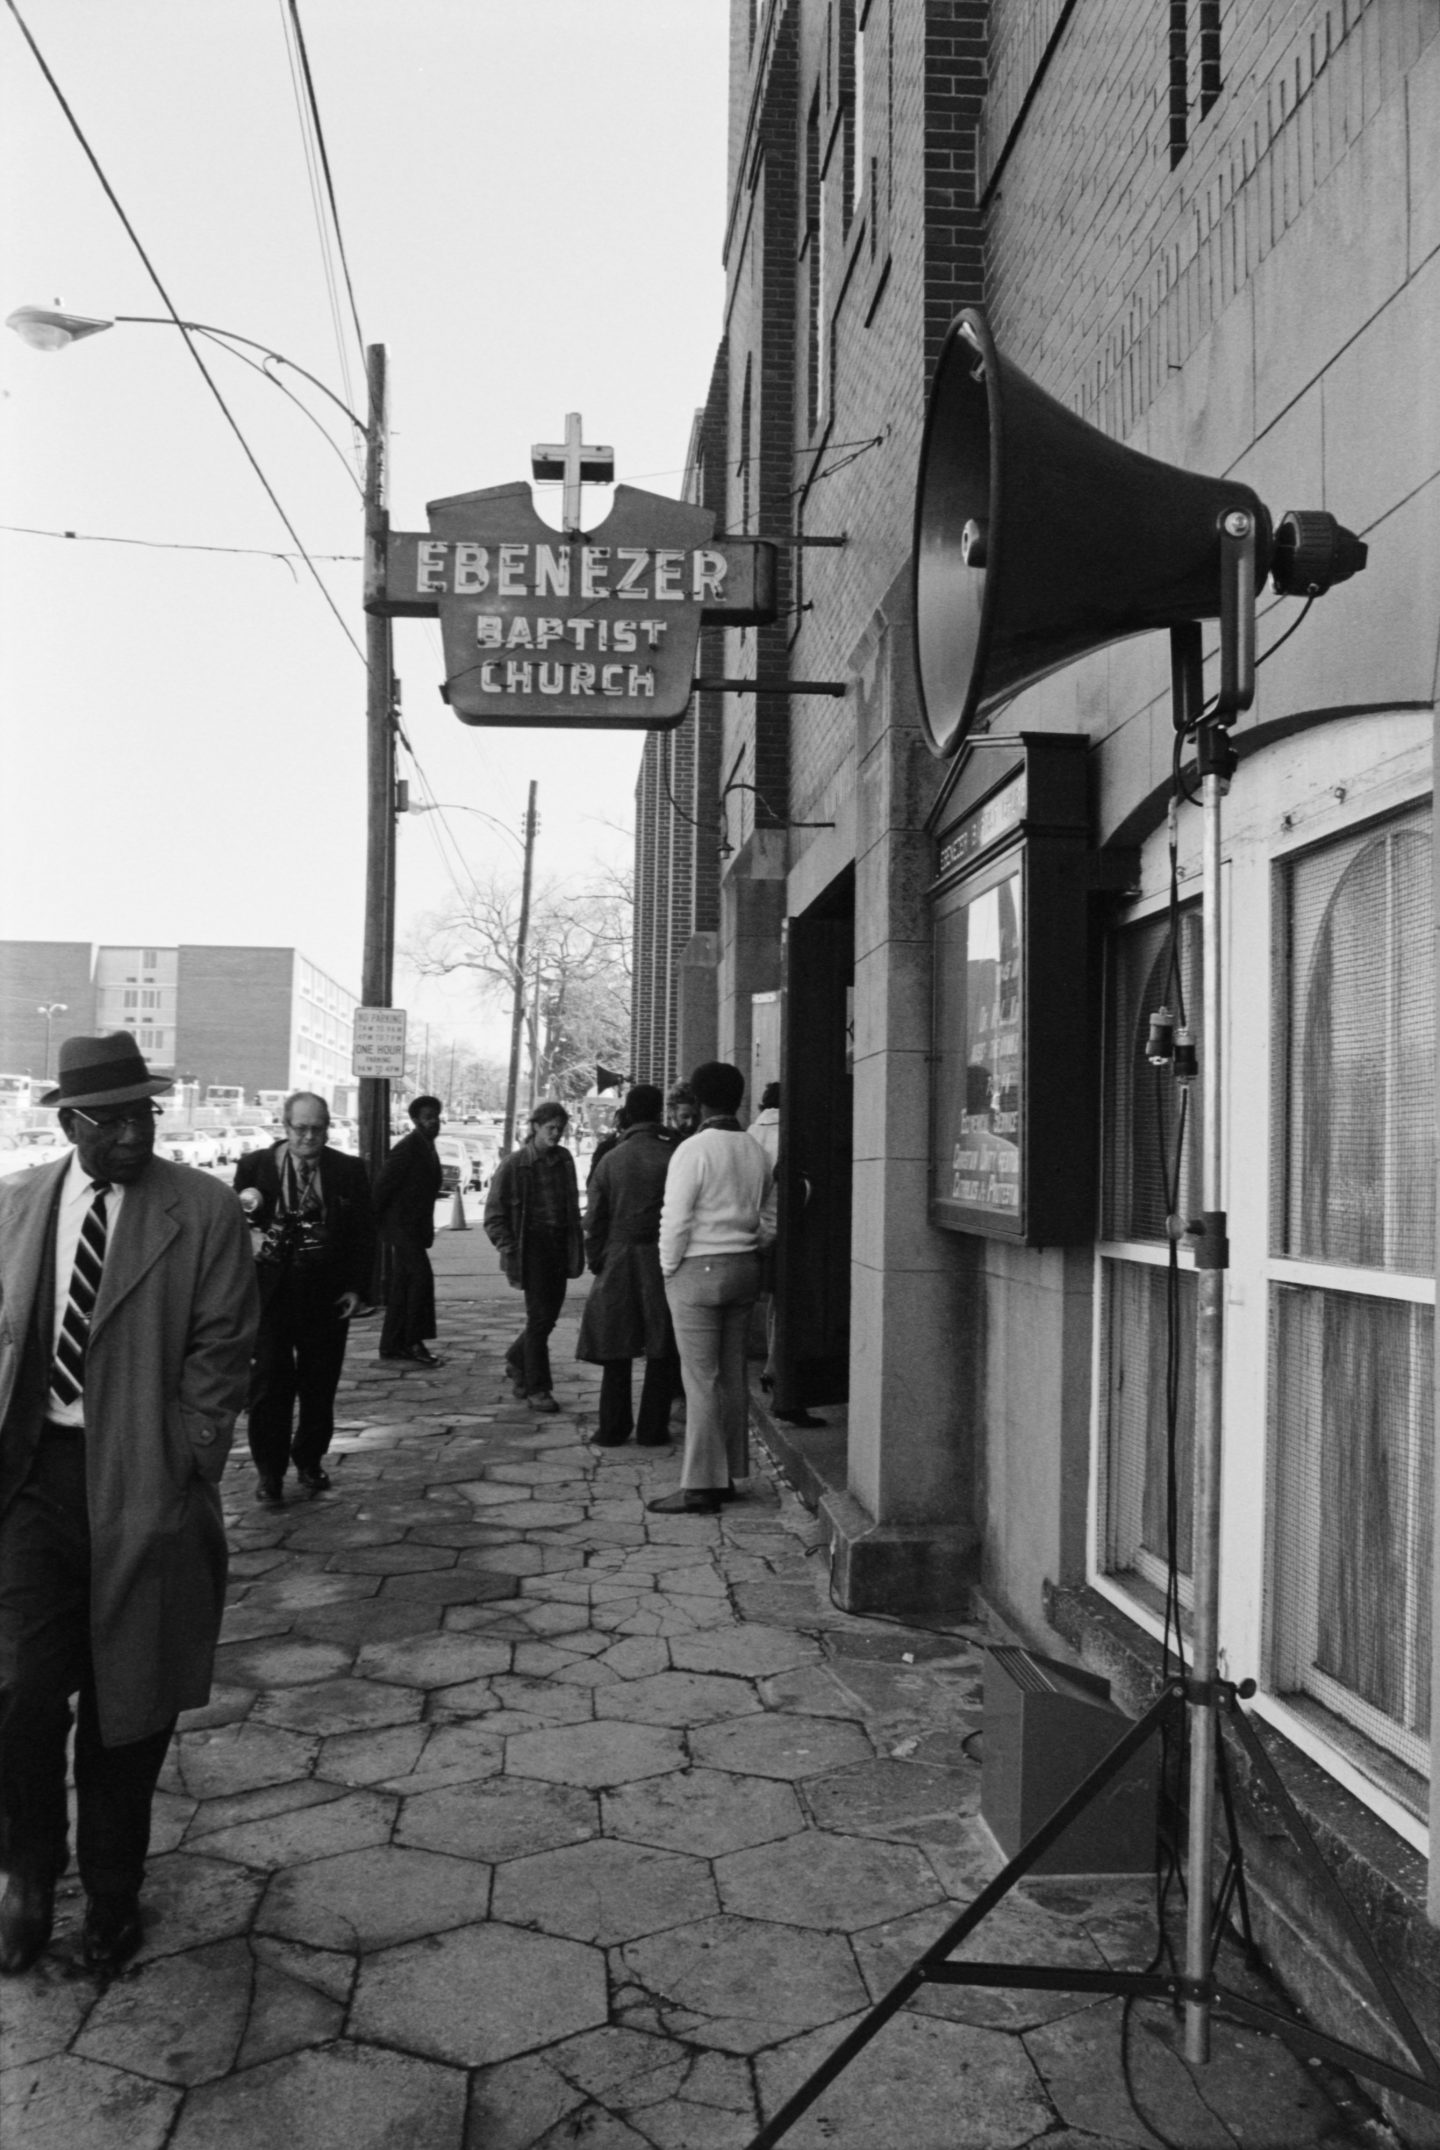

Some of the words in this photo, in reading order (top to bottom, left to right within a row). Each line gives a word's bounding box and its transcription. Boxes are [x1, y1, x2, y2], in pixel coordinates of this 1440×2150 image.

[416, 540, 728, 602] EBENEZER
[476, 615, 668, 653] BAPTIST
[480, 659, 656, 697] CHURCH
[358, 1013, 370, 1022] NO
[371, 1014, 402, 1025] PARKING
[376, 1025, 385, 1033] TO
[356, 1044, 373, 1055] ONE
[377, 1045, 402, 1055] HOUR
[375, 1065, 383, 1073] TO
